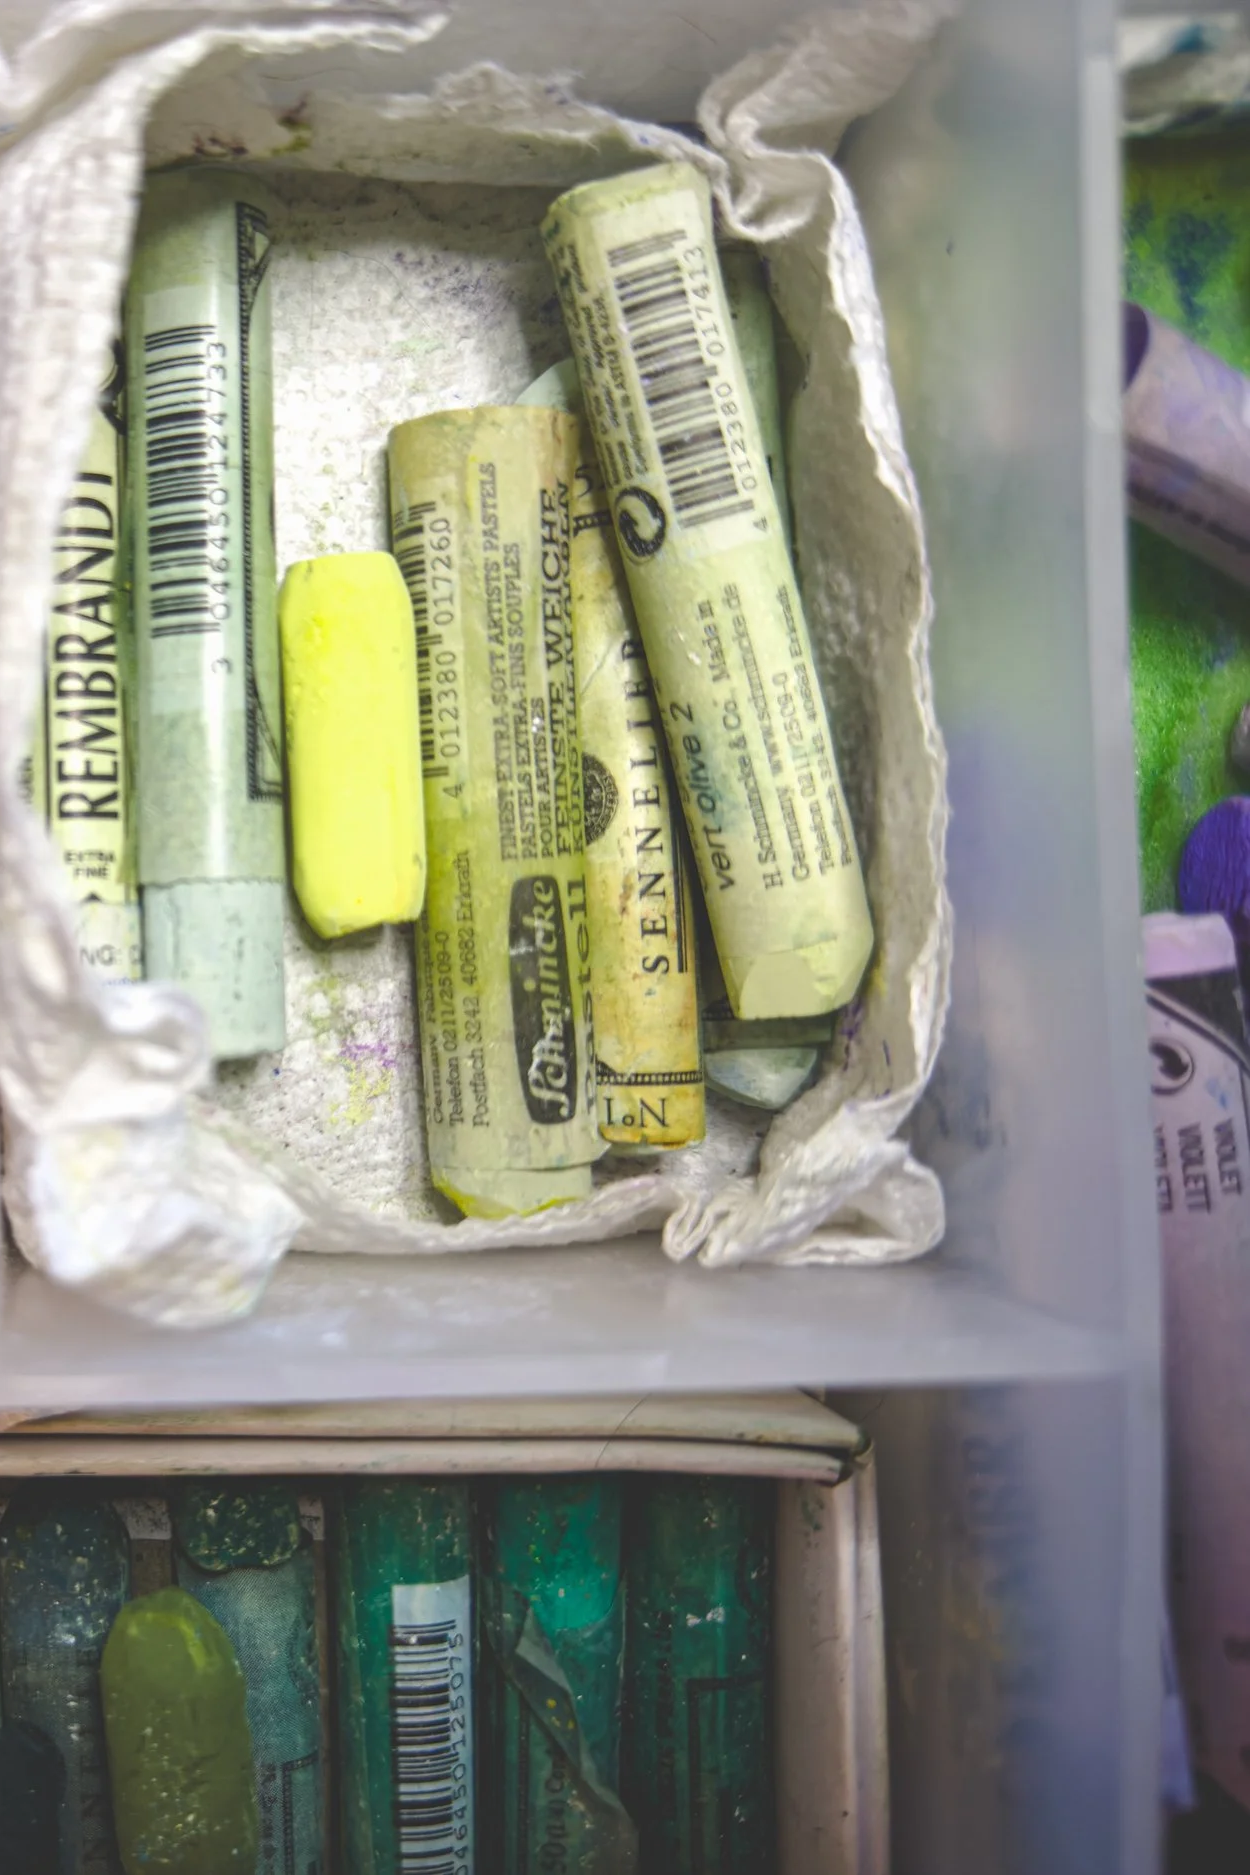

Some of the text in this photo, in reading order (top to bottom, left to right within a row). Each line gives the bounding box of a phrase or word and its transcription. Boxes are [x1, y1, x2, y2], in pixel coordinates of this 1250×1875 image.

[683, 245, 770, 533] 4 012380 017413
[207, 340, 234, 674] 3 046450 124733
[478, 461, 499, 551] PASTELS
[429, 516, 463, 799] 4 012380 017260
[502, 542, 537, 859] PASTELS EXTRA-FINS SOUPLES
[539, 487, 572, 856] FEINSTE WEICHE
[701, 620, 731, 683] Made
[530, 697, 554, 858] POUR ARTISTES
[669, 701, 736, 892] vert olive 2
[737, 755, 778, 864] Schmincke
[63, 850, 116, 866] EXTRA
[73, 866, 110, 880] FINE
[452, 850, 473, 922] Erkrath
[808, 800, 837, 877] Telefon
[457, 927, 477, 986] 40682
[522, 878, 571, 1118] Schmincke
[446, 1057, 465, 1127] Telefon
[466, 1048, 489, 1128] Postfach
[448, 1632, 467, 1755] 125075
